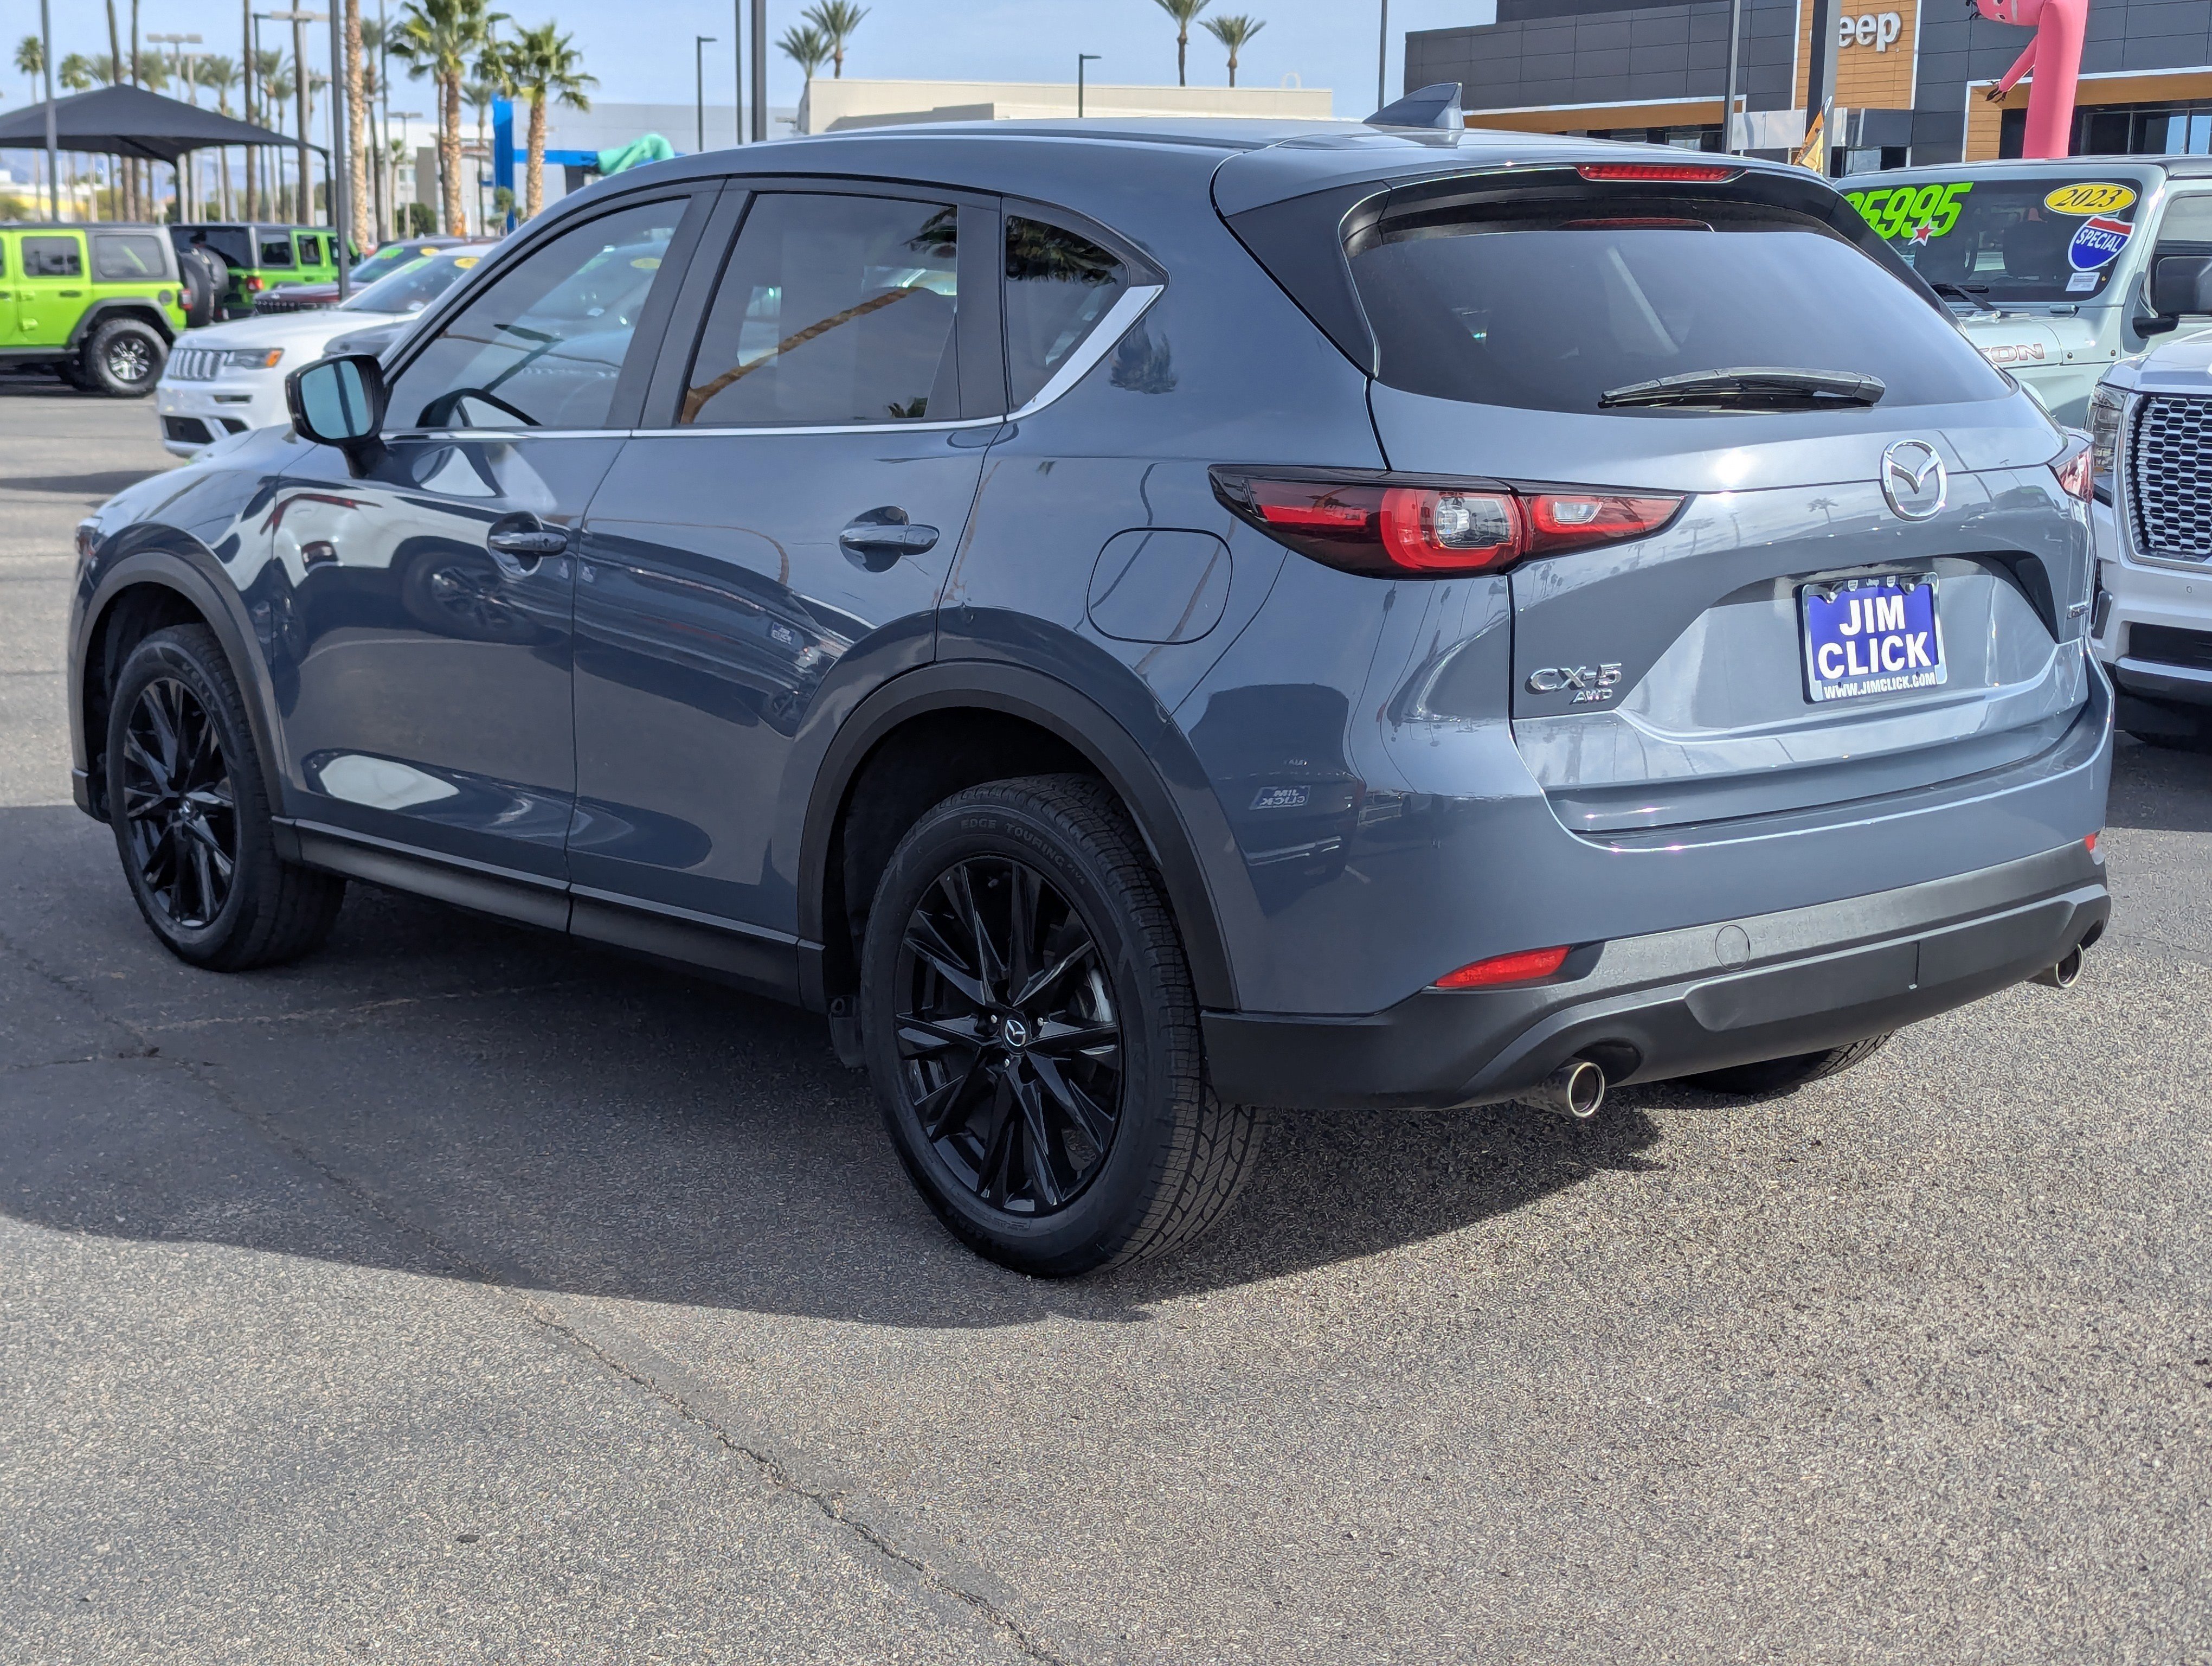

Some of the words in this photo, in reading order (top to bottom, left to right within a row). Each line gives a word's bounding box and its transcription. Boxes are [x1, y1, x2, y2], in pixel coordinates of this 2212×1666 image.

[1838, 12, 1901, 52] eep
[2054, 188, 2123, 208] 2023
[2075, 228, 2122, 253] SPECIAL
[1839, 594, 1906, 636] JIM
[1818, 631, 1932, 679] CLICK
[1526, 663, 1622, 691] CX-5
[1823, 671, 1936, 700] WWW.JIMCLICK.COM
[1570, 688, 1613, 704] AWD
[960, 818, 998, 829] EDGE
[1005, 823, 1065, 867] TOURING
